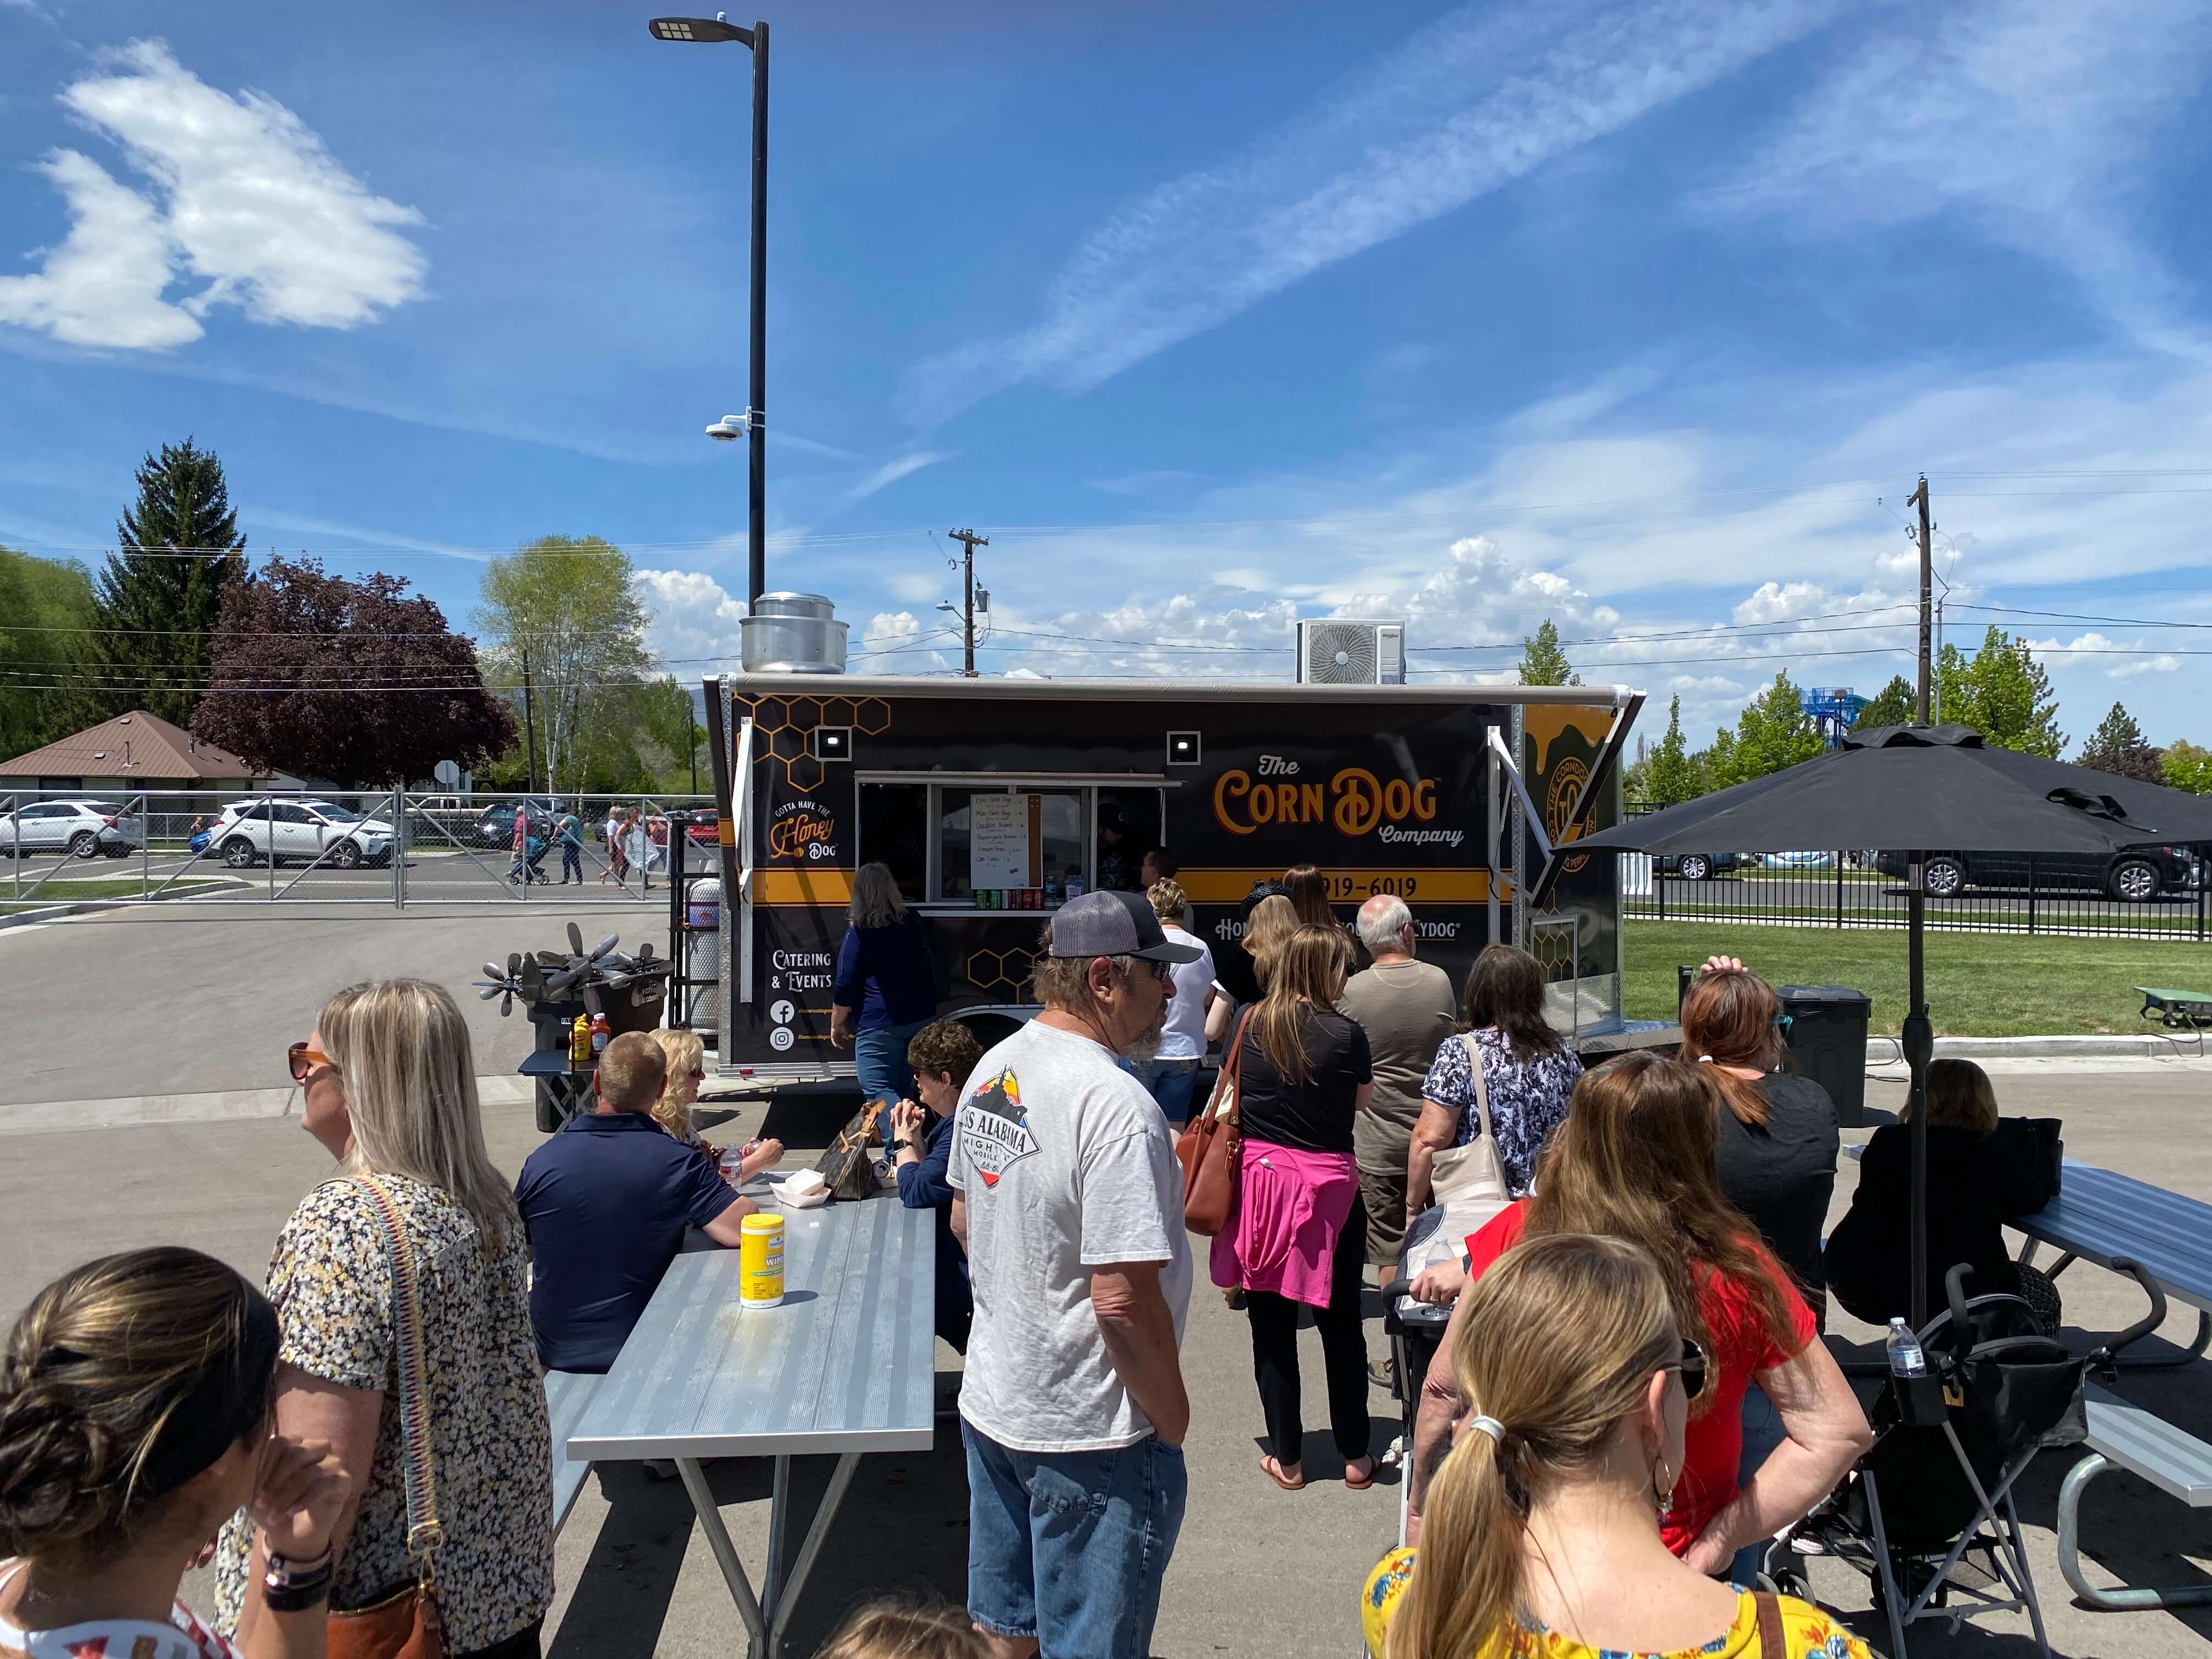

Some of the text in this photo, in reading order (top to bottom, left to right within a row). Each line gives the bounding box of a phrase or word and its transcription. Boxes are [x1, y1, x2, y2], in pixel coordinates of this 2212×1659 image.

[1259, 755, 1300, 775] The
[775, 801, 831, 817] GOTTA HAVE THE
[1213, 770, 1324, 837] CORN
[770, 814, 834, 859] Honey
[1379, 825, 1464, 848] Company
[772, 950, 831, 970] CATERING
[771, 971, 832, 992] & EVENTS
[977, 1115, 1026, 1153] ALABAMA
[973, 1149, 997, 1161] MOBILE
